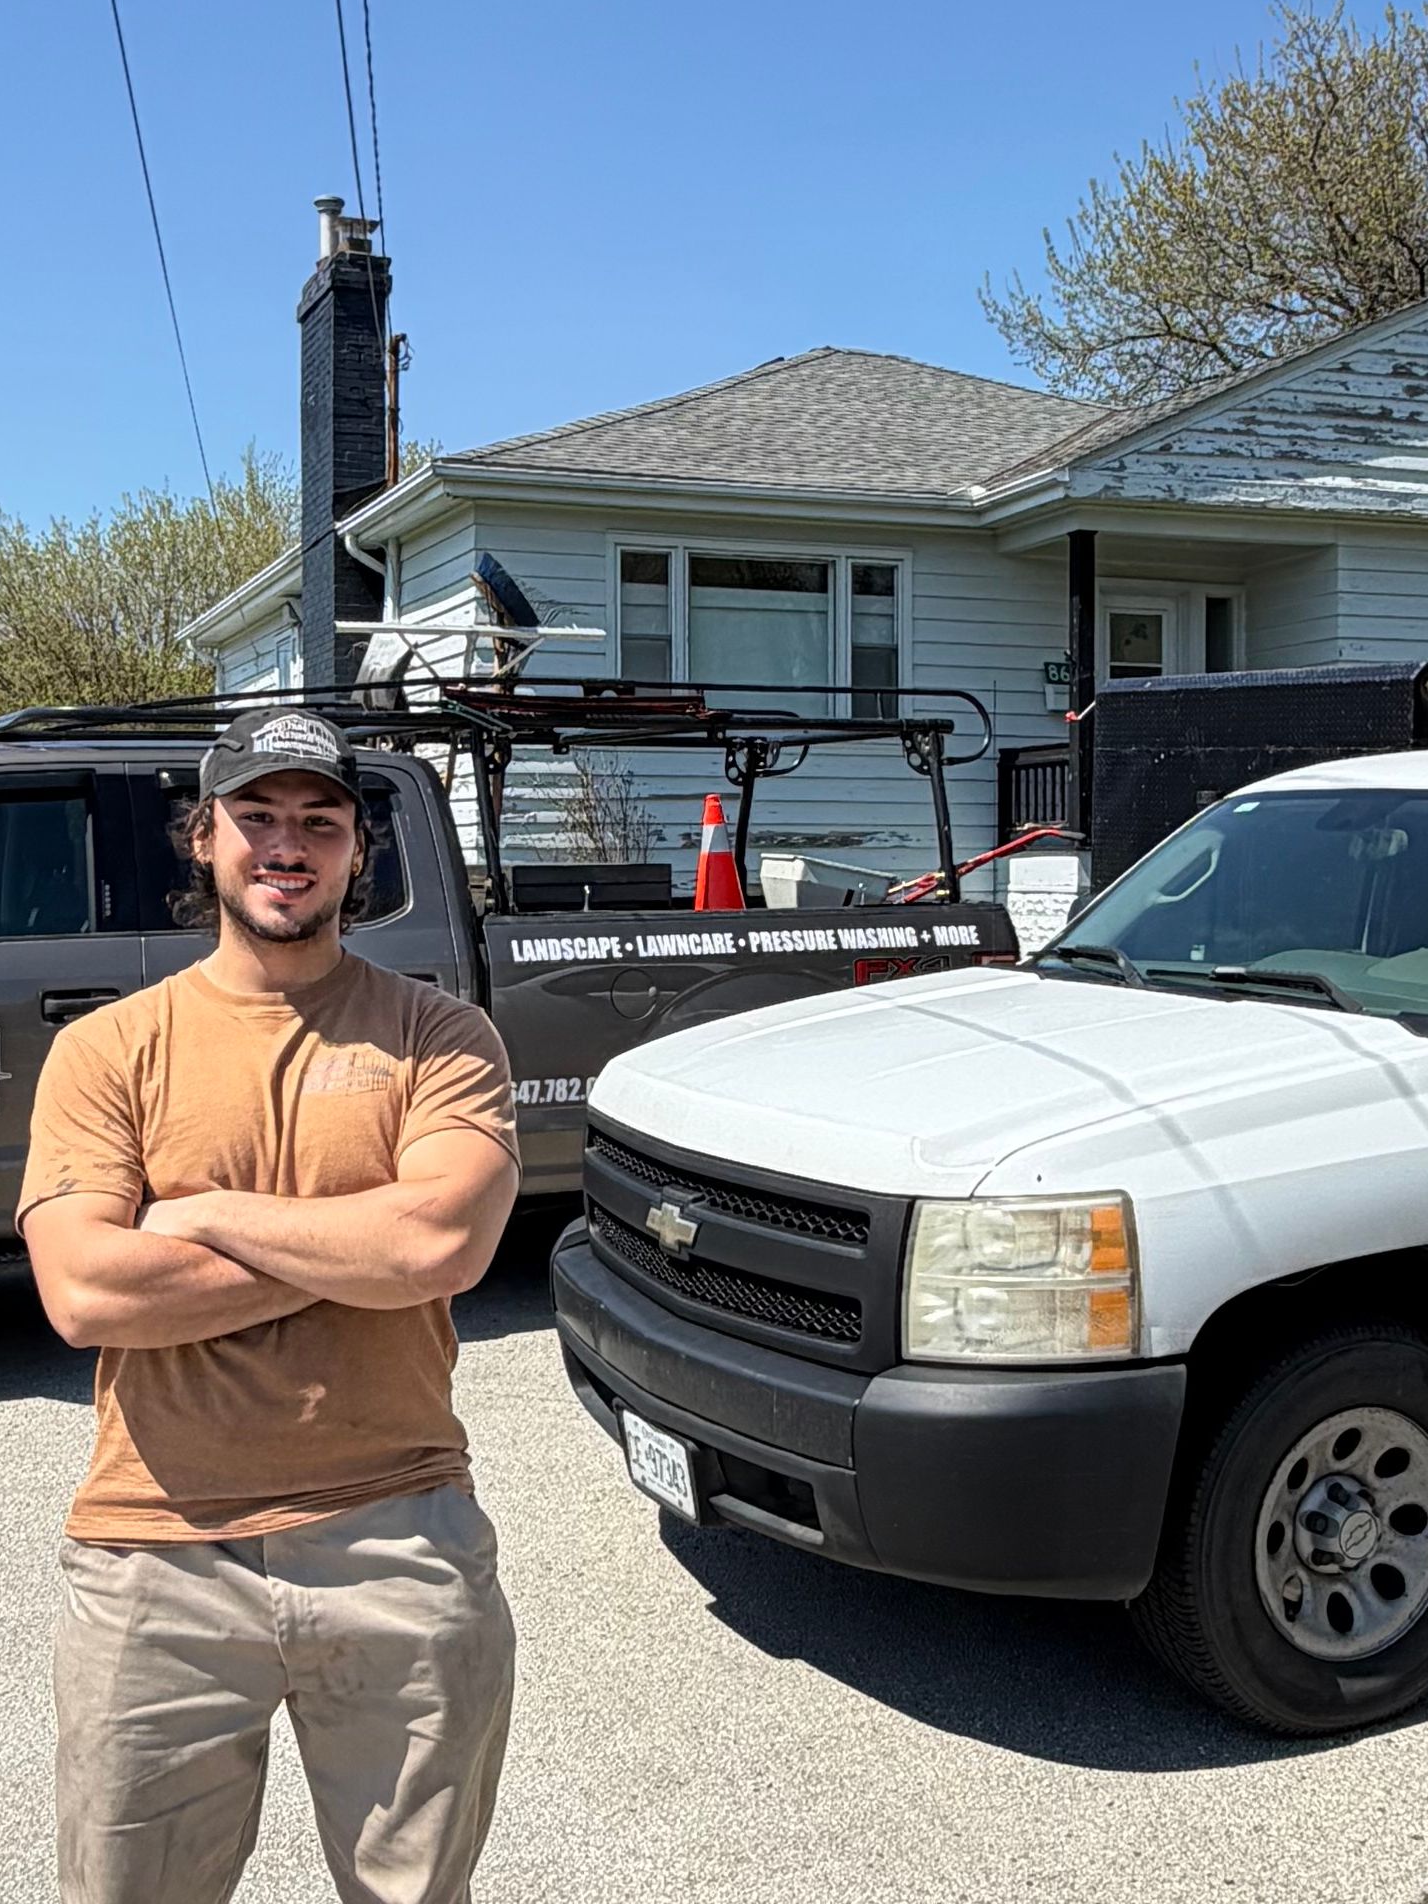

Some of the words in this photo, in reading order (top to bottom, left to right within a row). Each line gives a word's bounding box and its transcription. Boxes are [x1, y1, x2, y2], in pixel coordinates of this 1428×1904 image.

[1048, 664, 1070, 682] 86
[511, 936, 623, 963] LANDSCAPE
[636, 932, 737, 958] LAWNCARE
[748, 928, 838, 953] PRESSURE
[837, 925, 919, 950] WASHING
[932, 924, 980, 947] MORE
